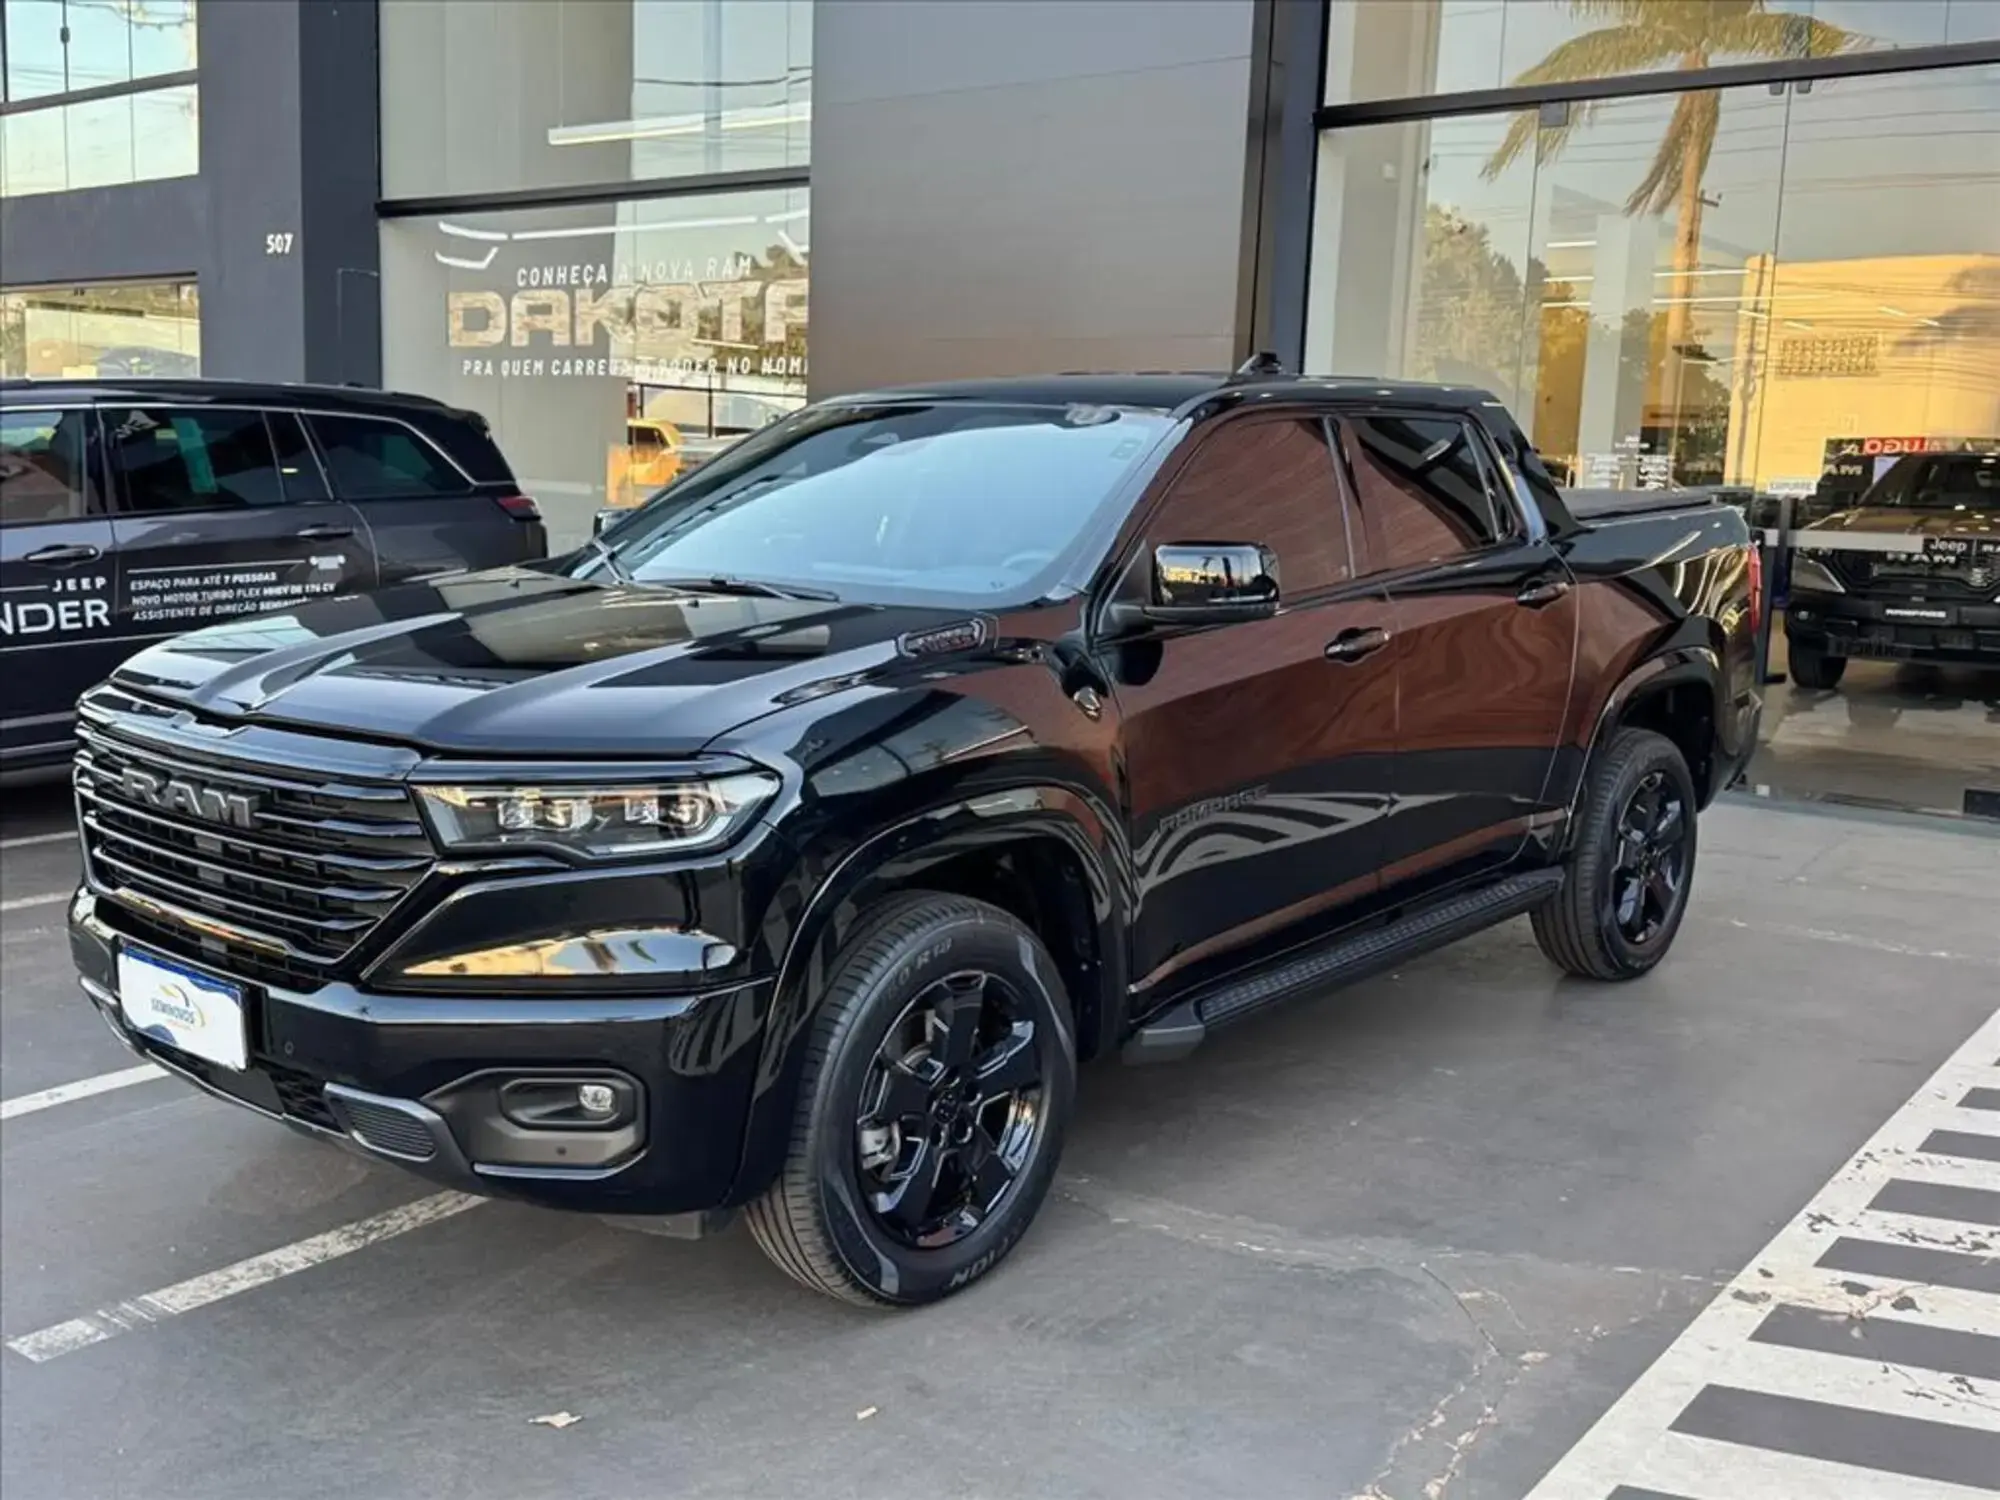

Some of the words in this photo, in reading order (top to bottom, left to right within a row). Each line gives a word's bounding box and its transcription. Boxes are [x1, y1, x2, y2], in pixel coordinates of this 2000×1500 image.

[266, 232, 294, 254] 507
[517, 264, 608, 287] CONHEÇA
[618, 263, 628, 281] A
[642, 261, 693, 281] NOVA
[706, 256, 752, 278] RAM
[448, 278, 809, 348] DAKOTA
[463, 360, 493, 376] PRA
[501, 359, 545, 378] QUEM
[727, 356, 751, 375] NO
[762, 356, 809, 377] NOM
[53, 576, 108, 592] JEEP
[130, 579, 171, 591] ESPAÇO
[173, 577, 200, 588] PARA
[203, 574, 222, 586] ATÉ
[131, 595, 160, 606] NOVO
[163, 592, 199, 604] MOTOR
[201, 589, 234, 602] TURBO
[132, 607, 196, 621] ASSISTENTE
[199, 605, 212, 617] DE
[214, 602, 257, 616] DIREÇÃO
[122, 767, 254, 829] RAM
